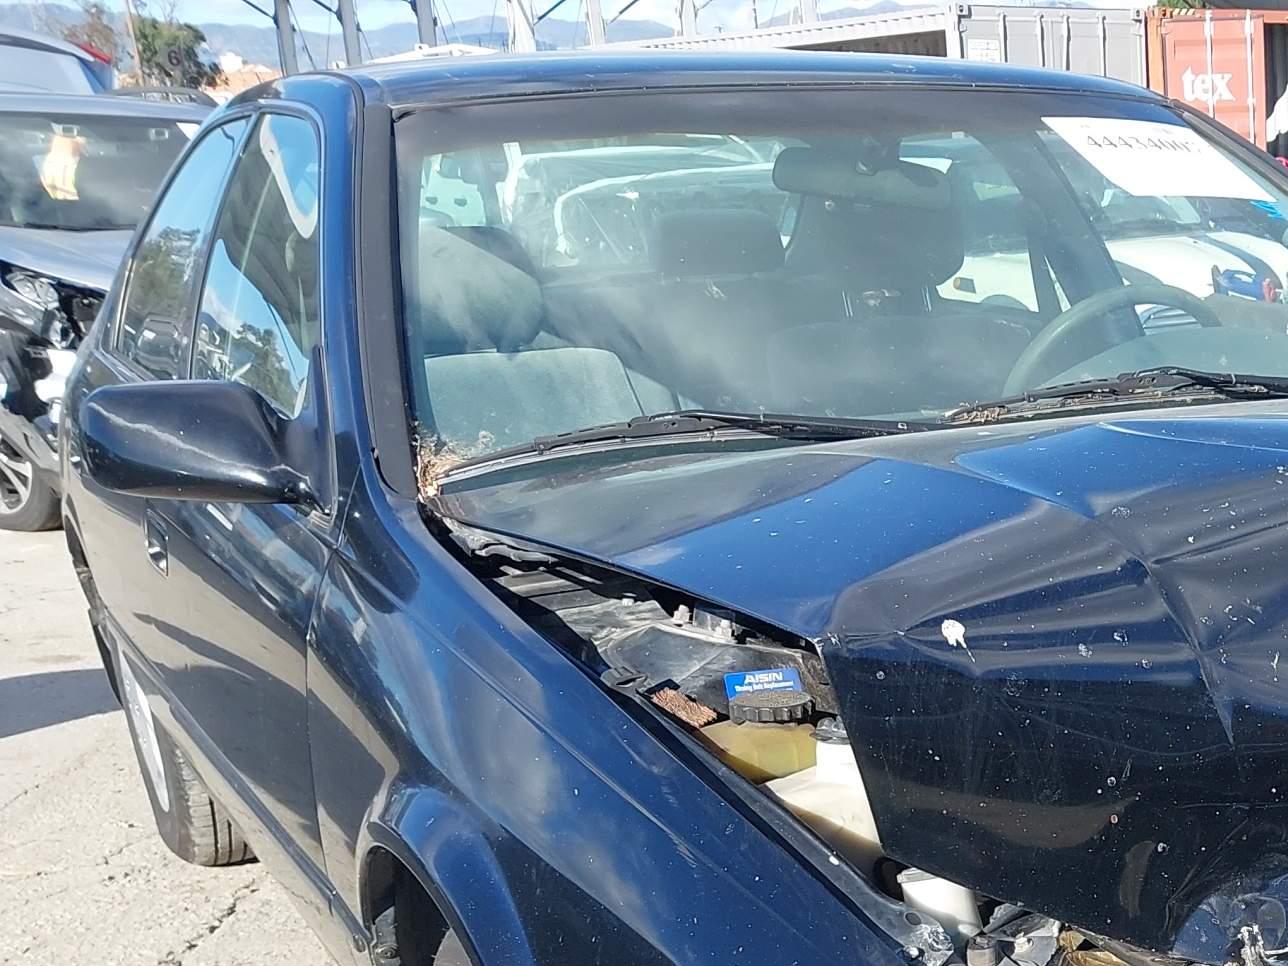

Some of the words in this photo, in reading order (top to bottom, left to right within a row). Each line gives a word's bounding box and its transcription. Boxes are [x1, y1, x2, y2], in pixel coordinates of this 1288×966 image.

[168, 50, 181, 67] 6
[1181, 64, 1237, 102] tex
[744, 671, 783, 684] AISIN
